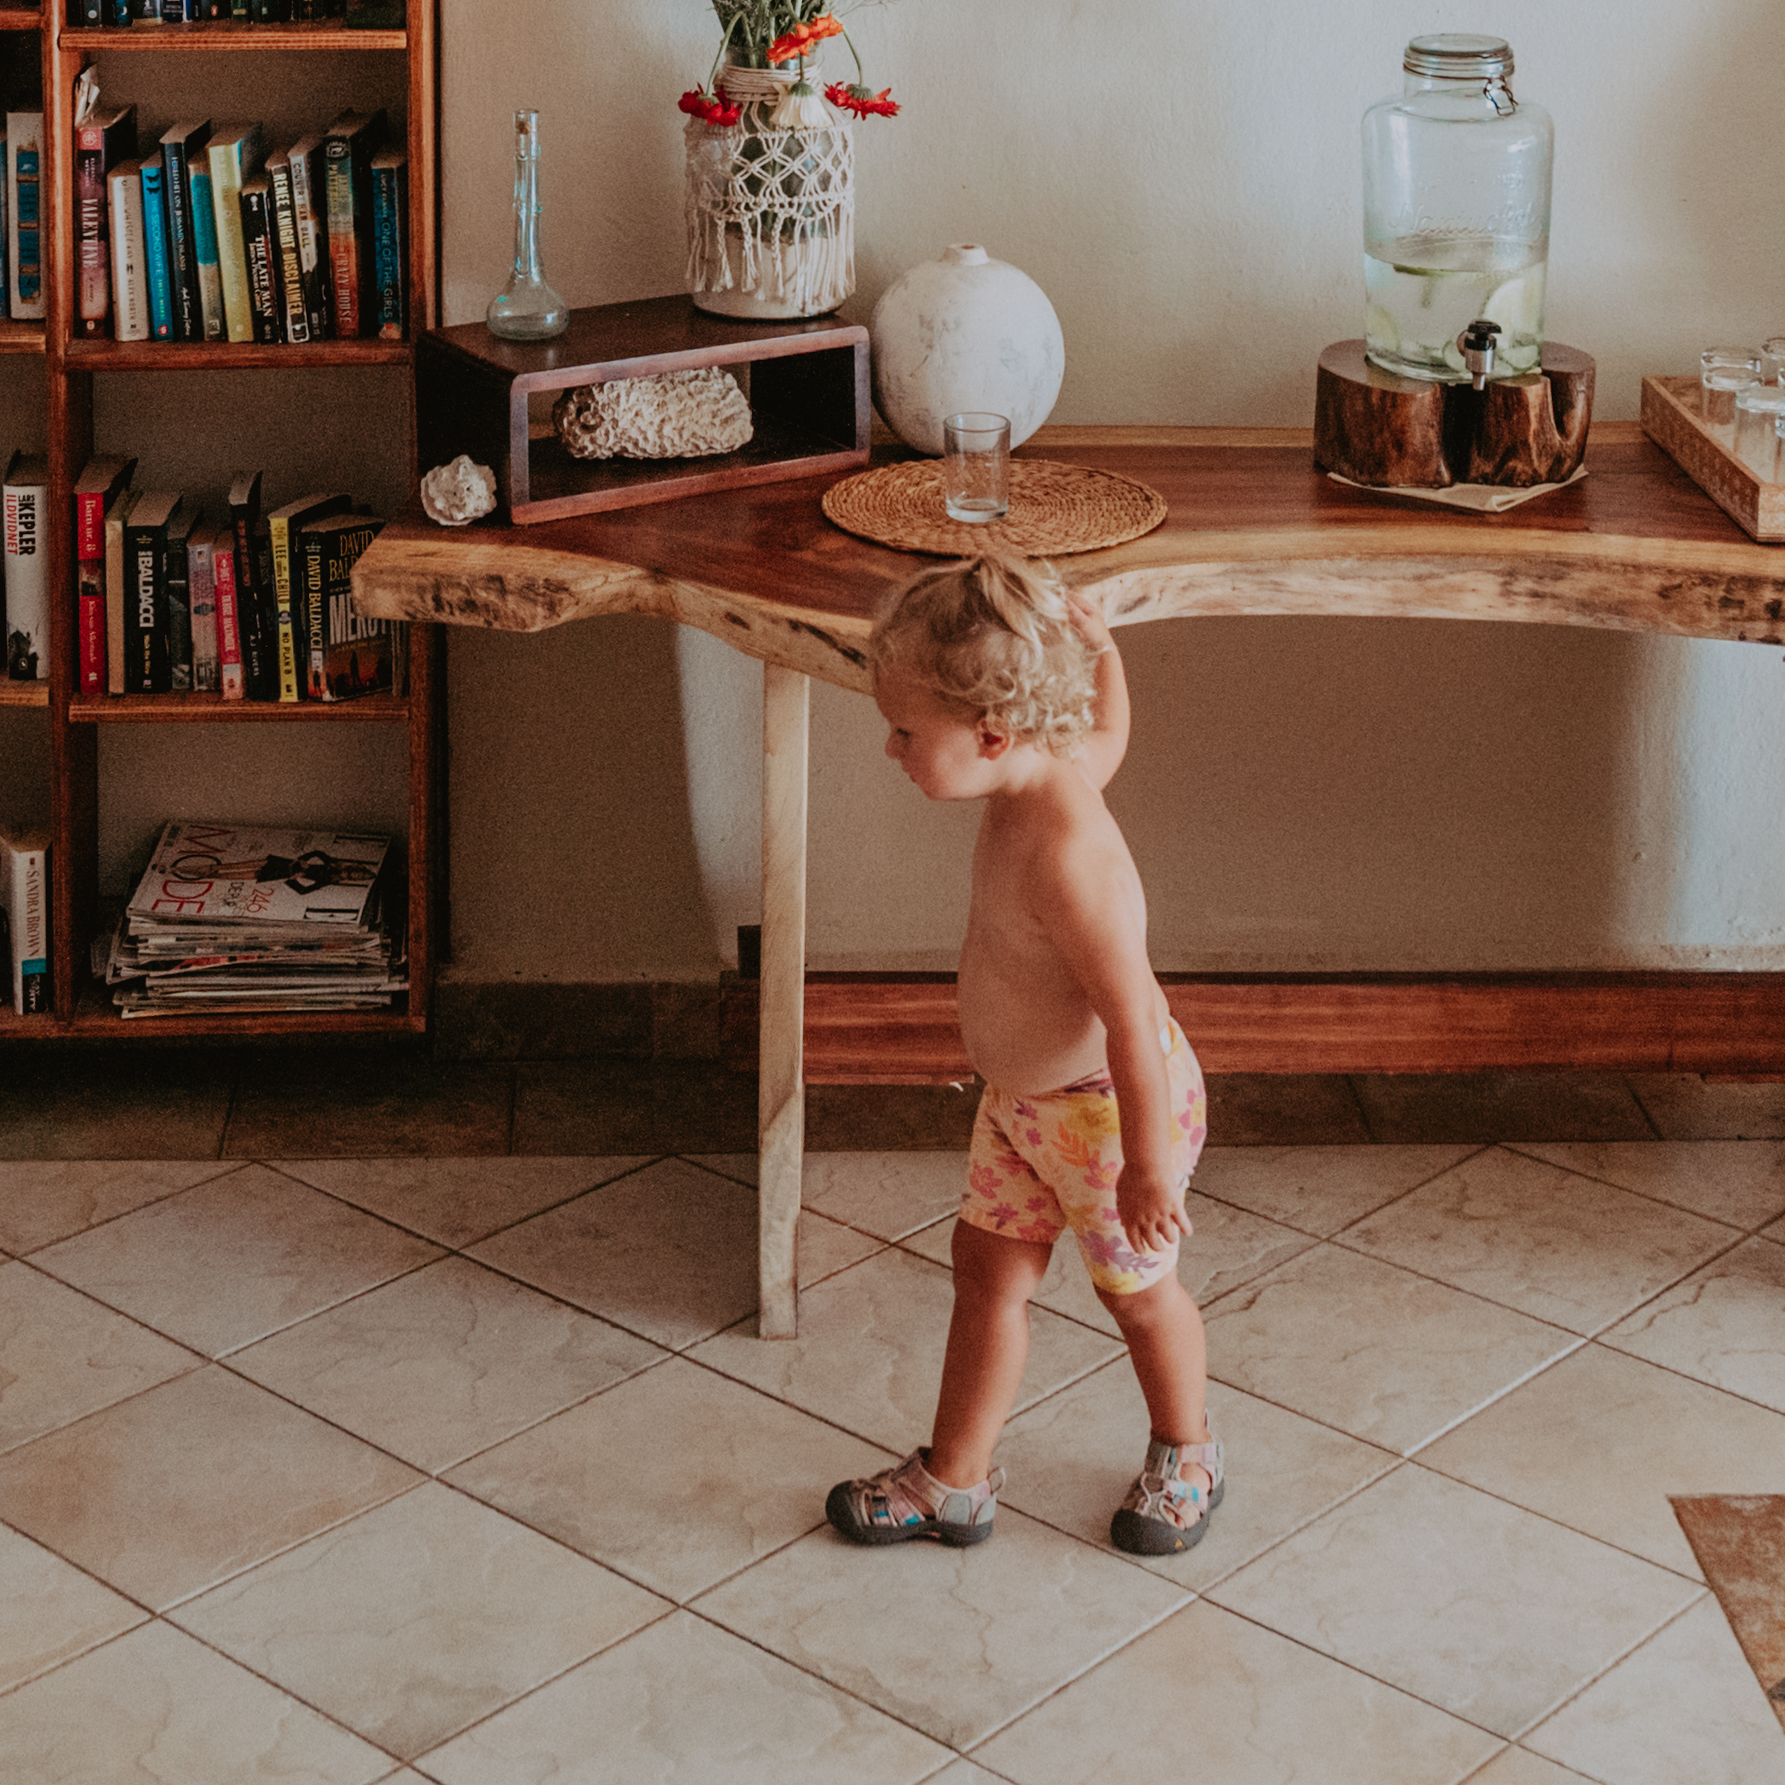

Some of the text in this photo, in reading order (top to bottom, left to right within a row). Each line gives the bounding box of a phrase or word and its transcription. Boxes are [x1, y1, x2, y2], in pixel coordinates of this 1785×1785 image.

[81, 198, 99, 267] VALENTINE
[273, 172, 295, 248] RENEE KNIGHT
[254, 234, 272, 317] THE LATE MAN
[281, 253, 302, 316] DISCLAIMER
[381, 222, 393, 319] ONE OF THE GIRLS
[338, 291, 350, 324] HOUSE
[6, 493, 18, 556] ILDVIDNET
[17, 494, 36, 503] LARS
[18, 502, 36, 556] KEPLER
[138, 559, 154, 628] BALDACCI
[275, 545, 290, 605] LEE CHILD
[306, 555, 322, 650] DAVID BALDACCI
[281, 633, 291, 668] NO PLAN
[25, 869, 41, 957] SANDRA BROWN
